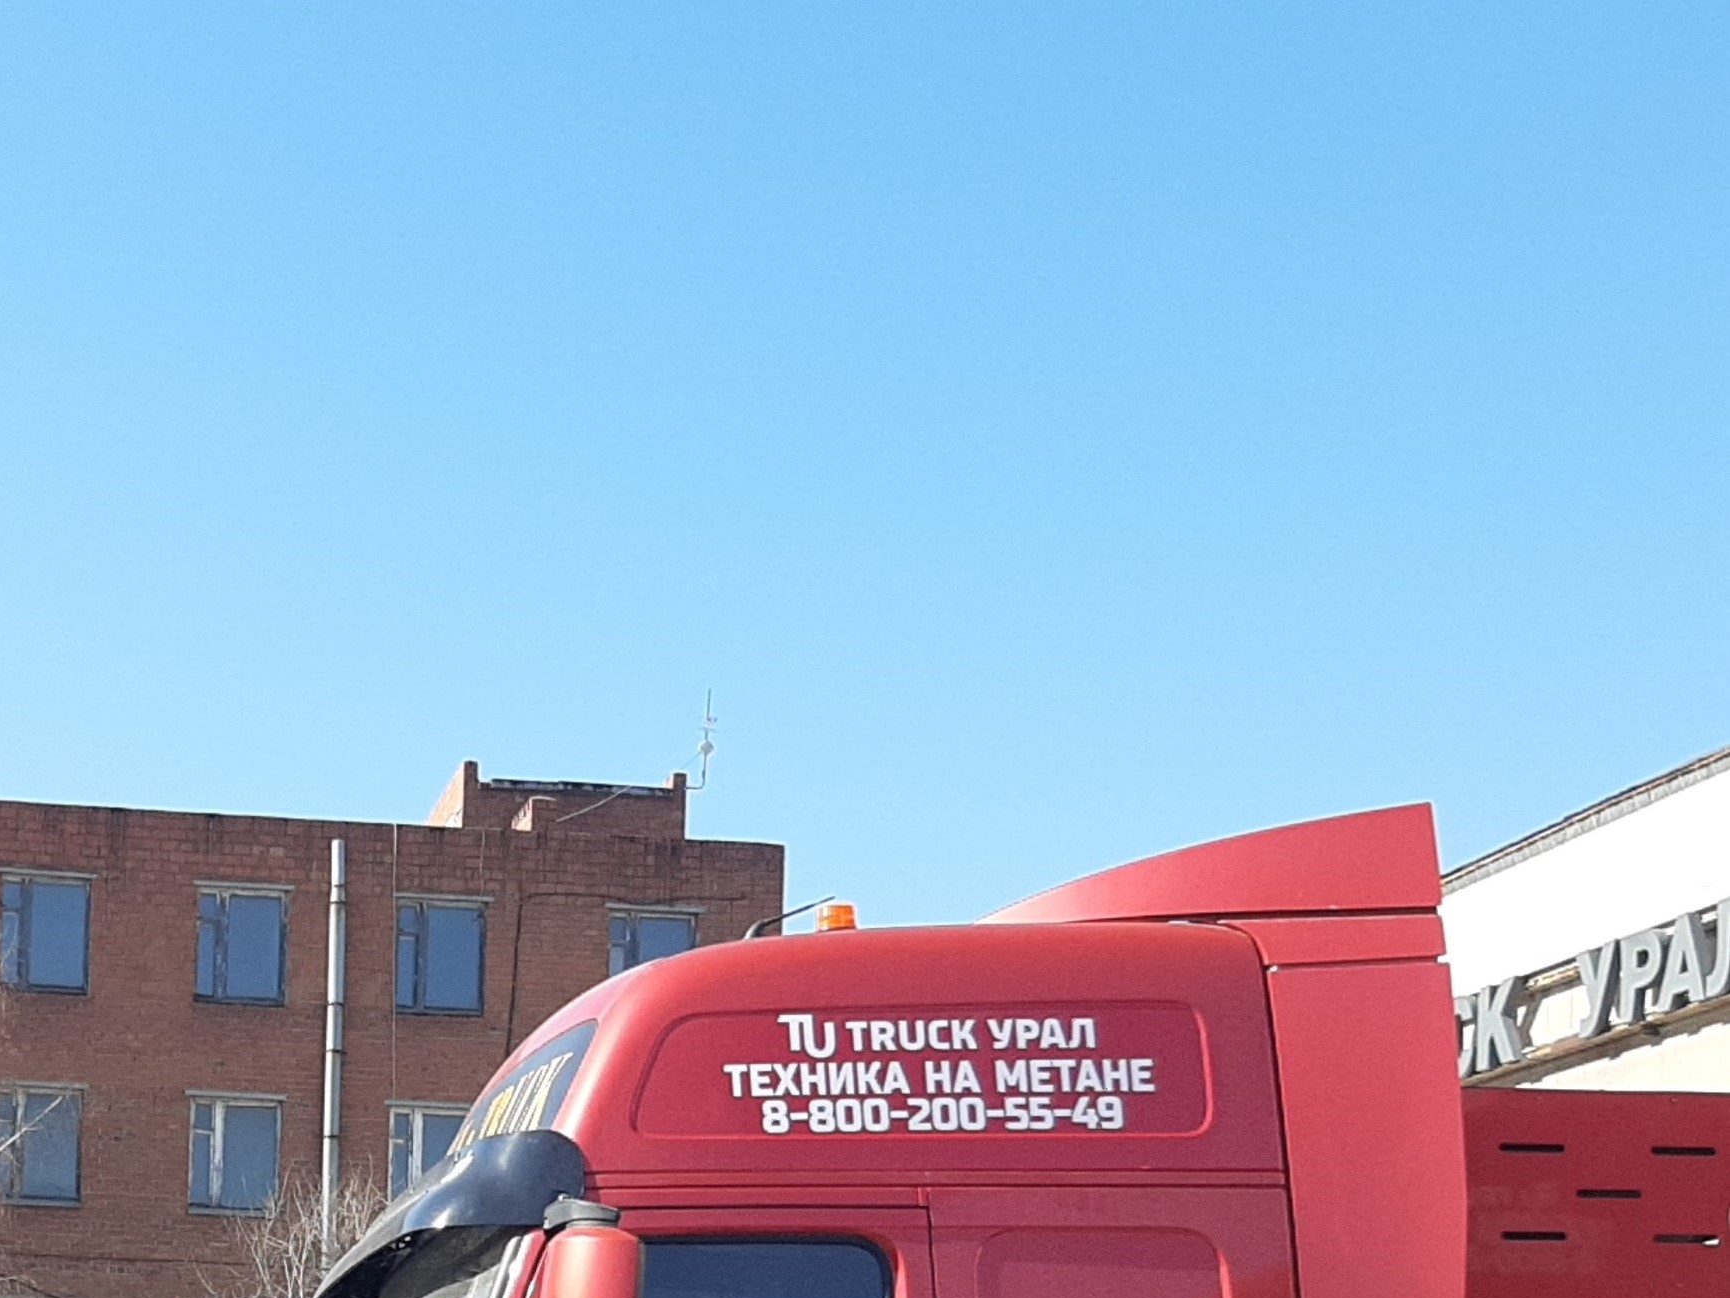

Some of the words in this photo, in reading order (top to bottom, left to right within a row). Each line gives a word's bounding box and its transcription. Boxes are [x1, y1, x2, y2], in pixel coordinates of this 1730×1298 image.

[845, 1020, 978, 1052] TRUCK
[987, 1017, 1096, 1050] УРАЛ
[723, 1061, 910, 1097] ТЕХНИКА
[924, 1061, 981, 1094] НА
[996, 1058, 1156, 1093] МЕТАНЕ
[761, 1096, 1125, 1133] 8-800-200-55-49
